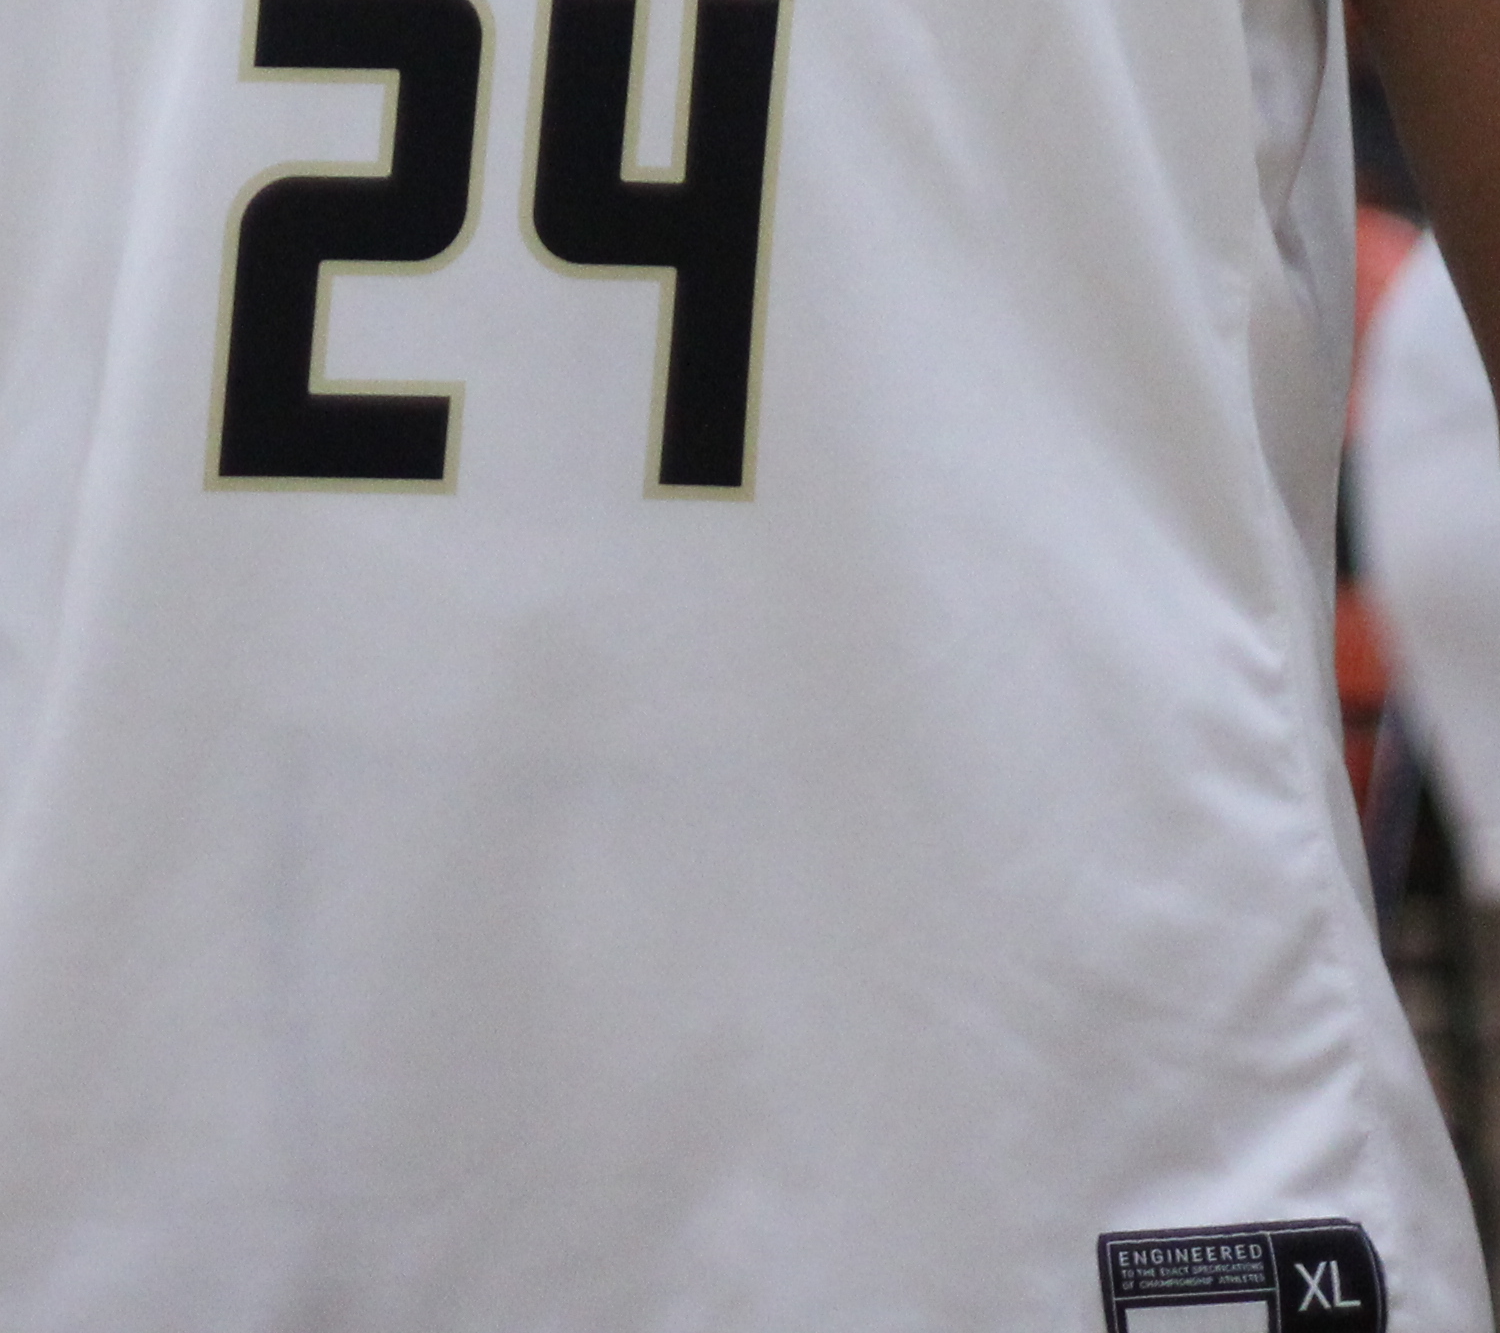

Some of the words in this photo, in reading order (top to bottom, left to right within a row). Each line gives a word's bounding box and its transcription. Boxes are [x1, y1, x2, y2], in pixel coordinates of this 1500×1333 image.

[1118, 1244, 1264, 1267] ENGINEERED
[1122, 1269, 1135, 1279] TO
[1137, 1268, 1155, 1278] THE
[1160, 1265, 1190, 1277] EXACT
[1293, 1259, 1362, 1312] XL
